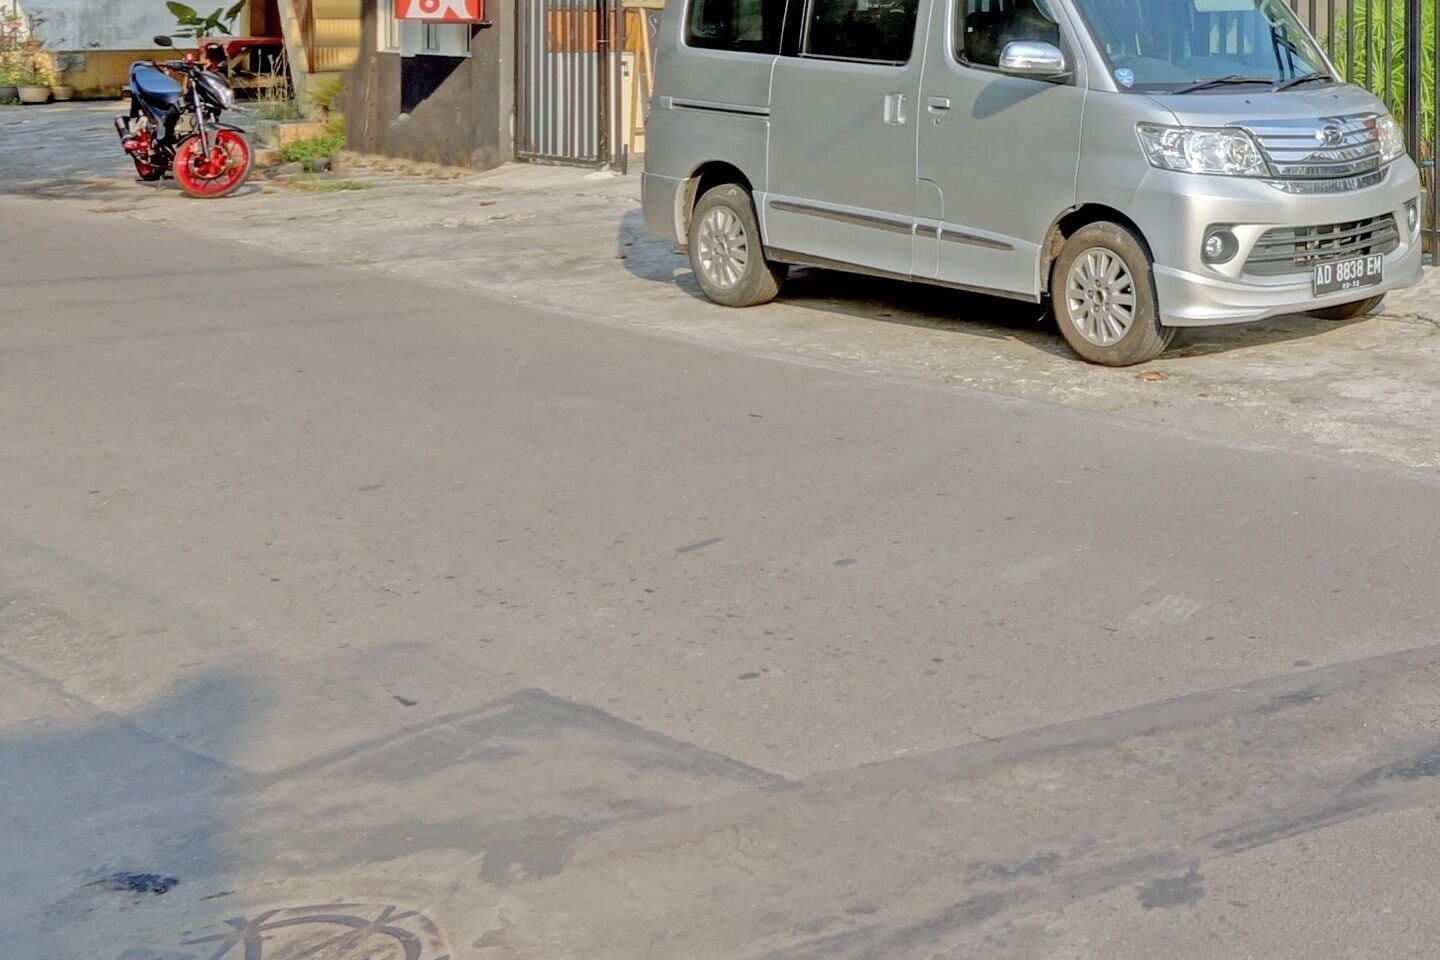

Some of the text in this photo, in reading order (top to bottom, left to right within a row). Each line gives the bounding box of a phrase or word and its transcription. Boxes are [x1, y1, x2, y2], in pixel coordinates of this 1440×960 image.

[1316, 255, 1381, 286] AD 8838 EM
